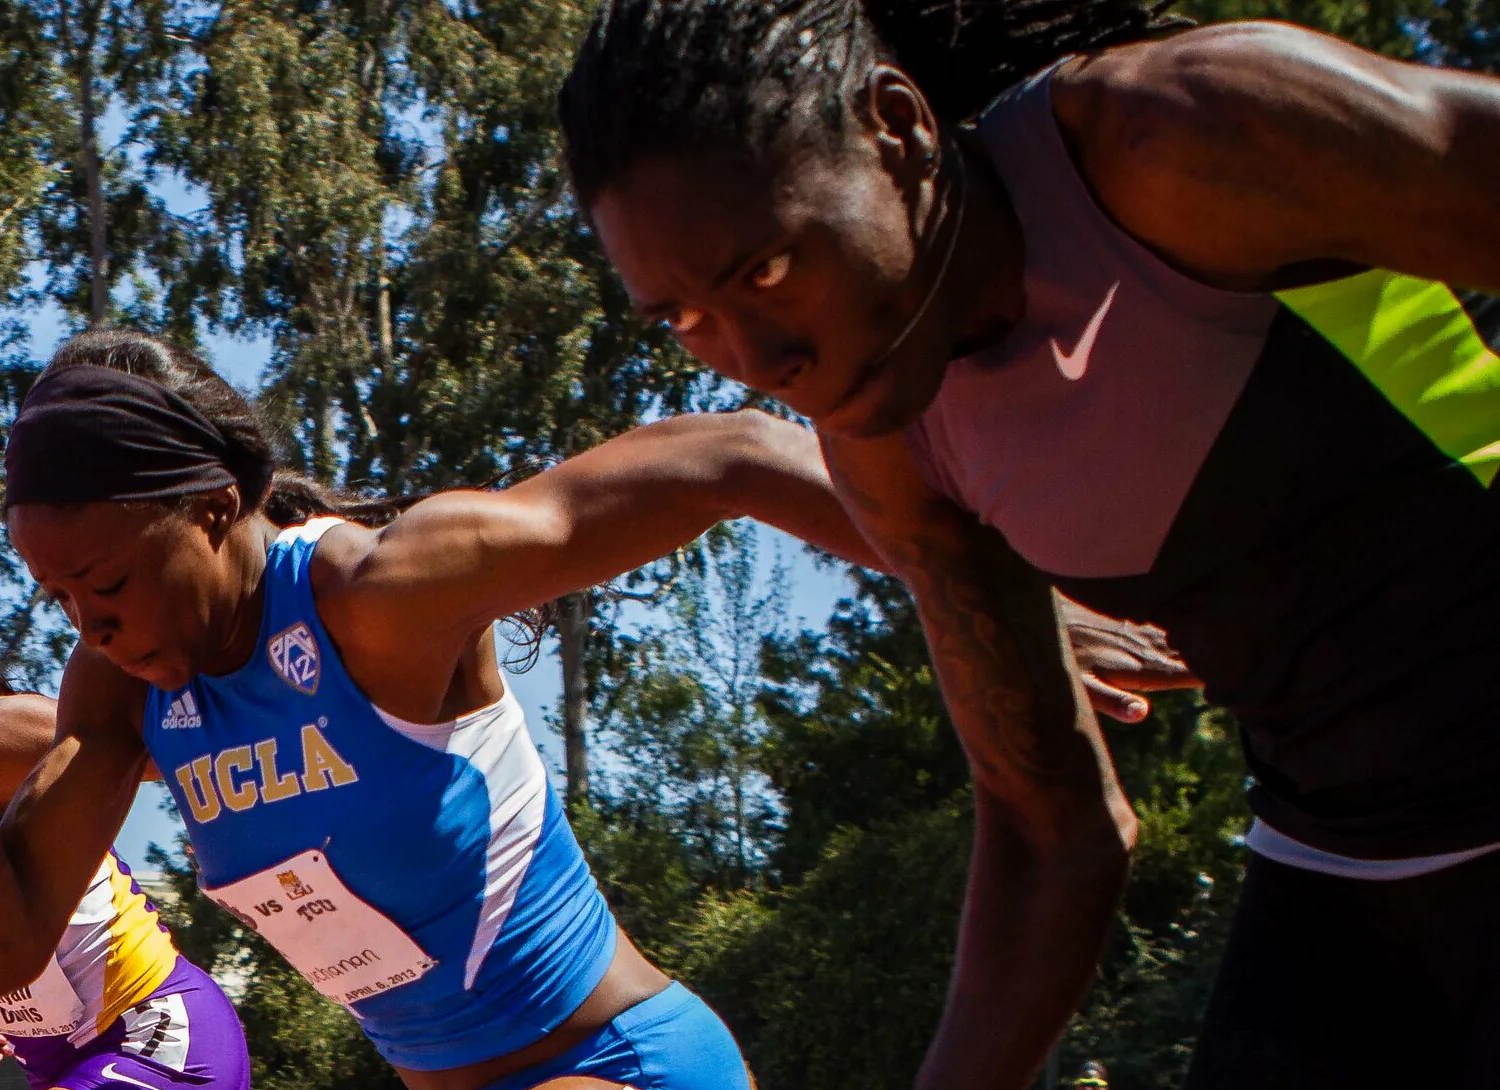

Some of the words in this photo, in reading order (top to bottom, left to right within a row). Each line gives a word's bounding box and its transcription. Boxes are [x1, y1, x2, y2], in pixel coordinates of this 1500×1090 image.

[269, 626, 317, 677] PAC
[289, 654, 317, 684] 12
[161, 714, 201, 730] adidas
[175, 724, 359, 824] UCLA
[296, 898, 337, 922] TCU
[345, 985, 376, 1001] APRIL
[387, 968, 417, 985] 2013
